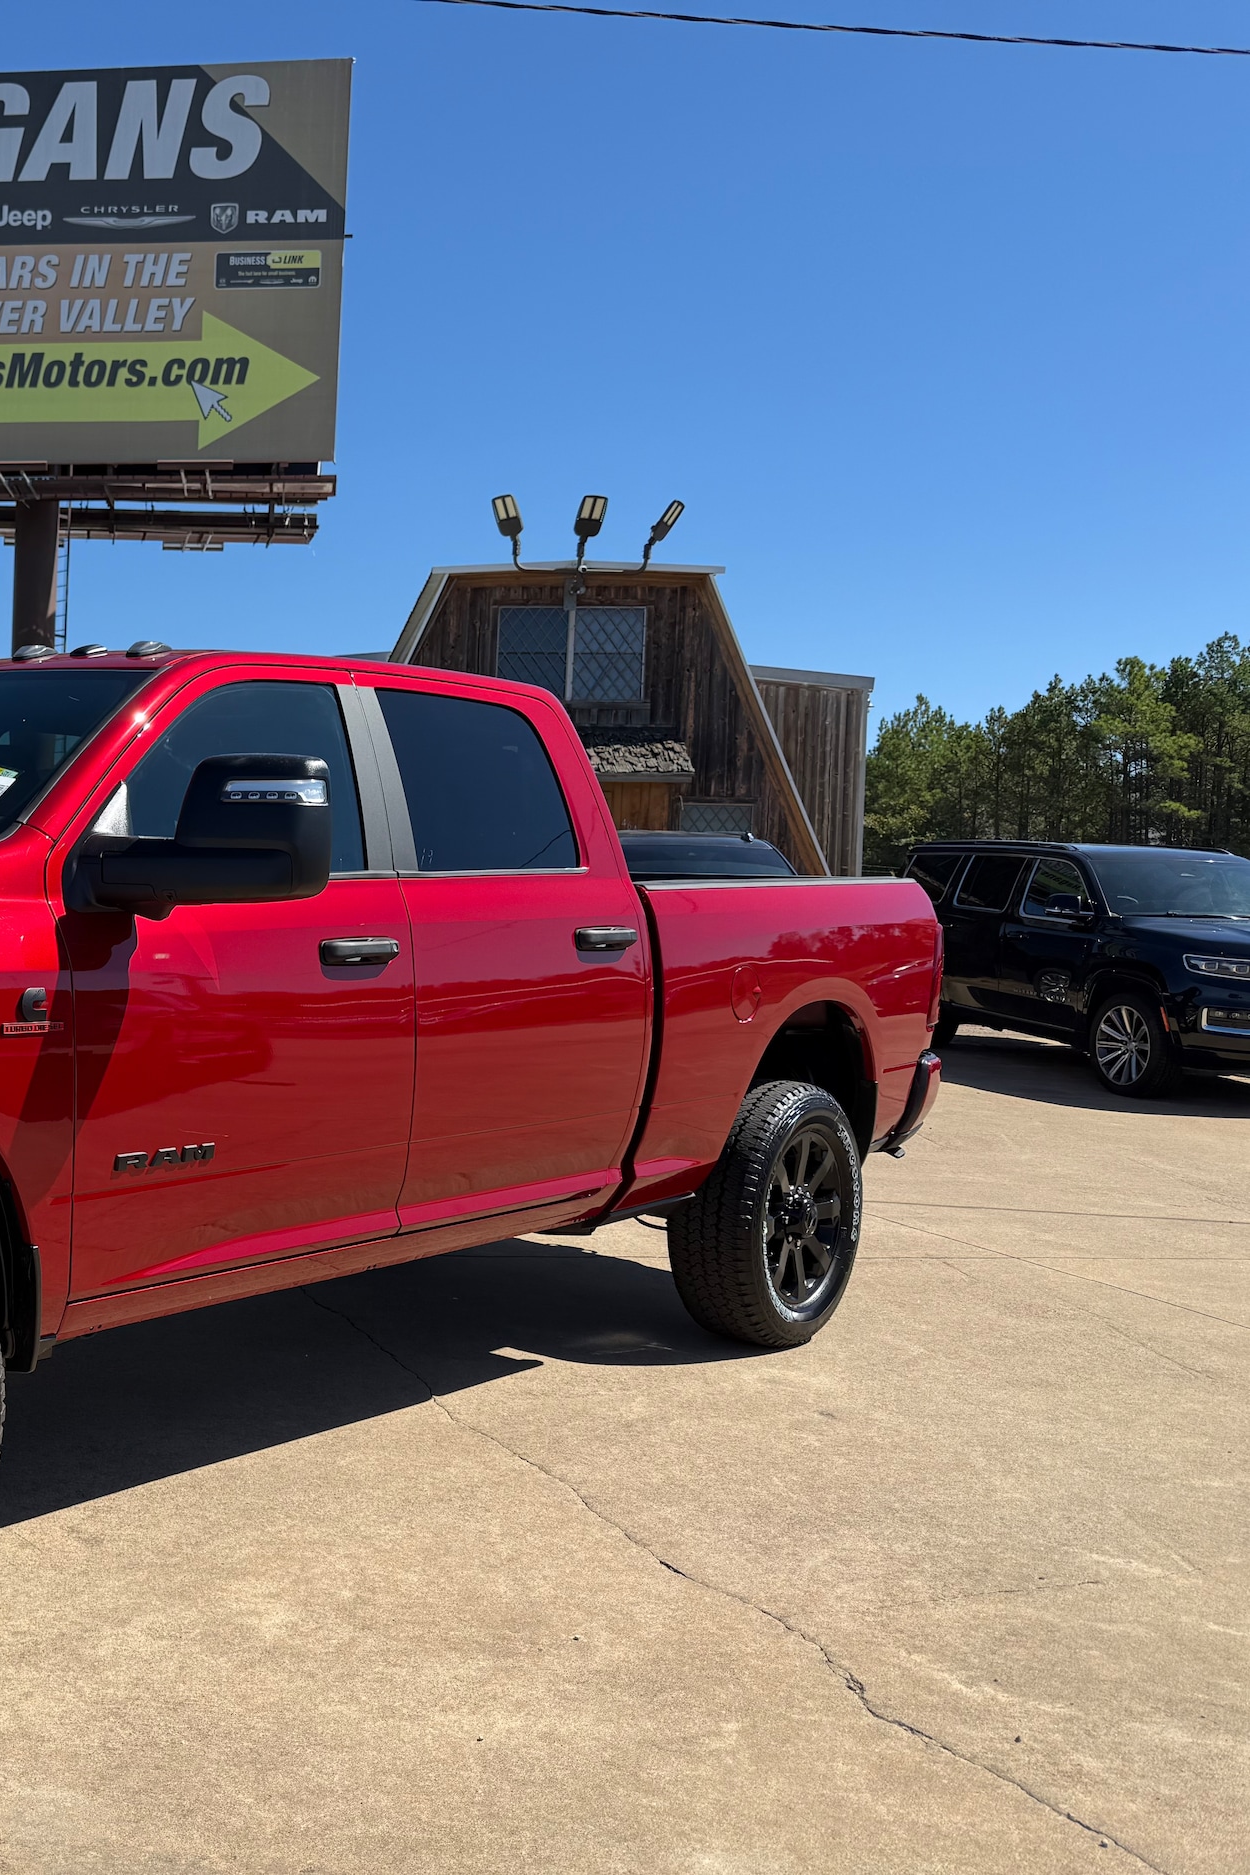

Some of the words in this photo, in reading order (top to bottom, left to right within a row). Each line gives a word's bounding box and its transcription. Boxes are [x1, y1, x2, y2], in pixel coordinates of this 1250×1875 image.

[80, 204, 180, 215] CHRYSLER
[246, 208, 328, 225] RAM
[70, 254, 119, 290] IN
[123, 252, 193, 288] THE
[229, 256, 266, 266] BUSINESS
[283, 255, 305, 265] LINK
[60, 297, 196, 334] VALLEY
[113, 1142, 216, 1173] RAM
